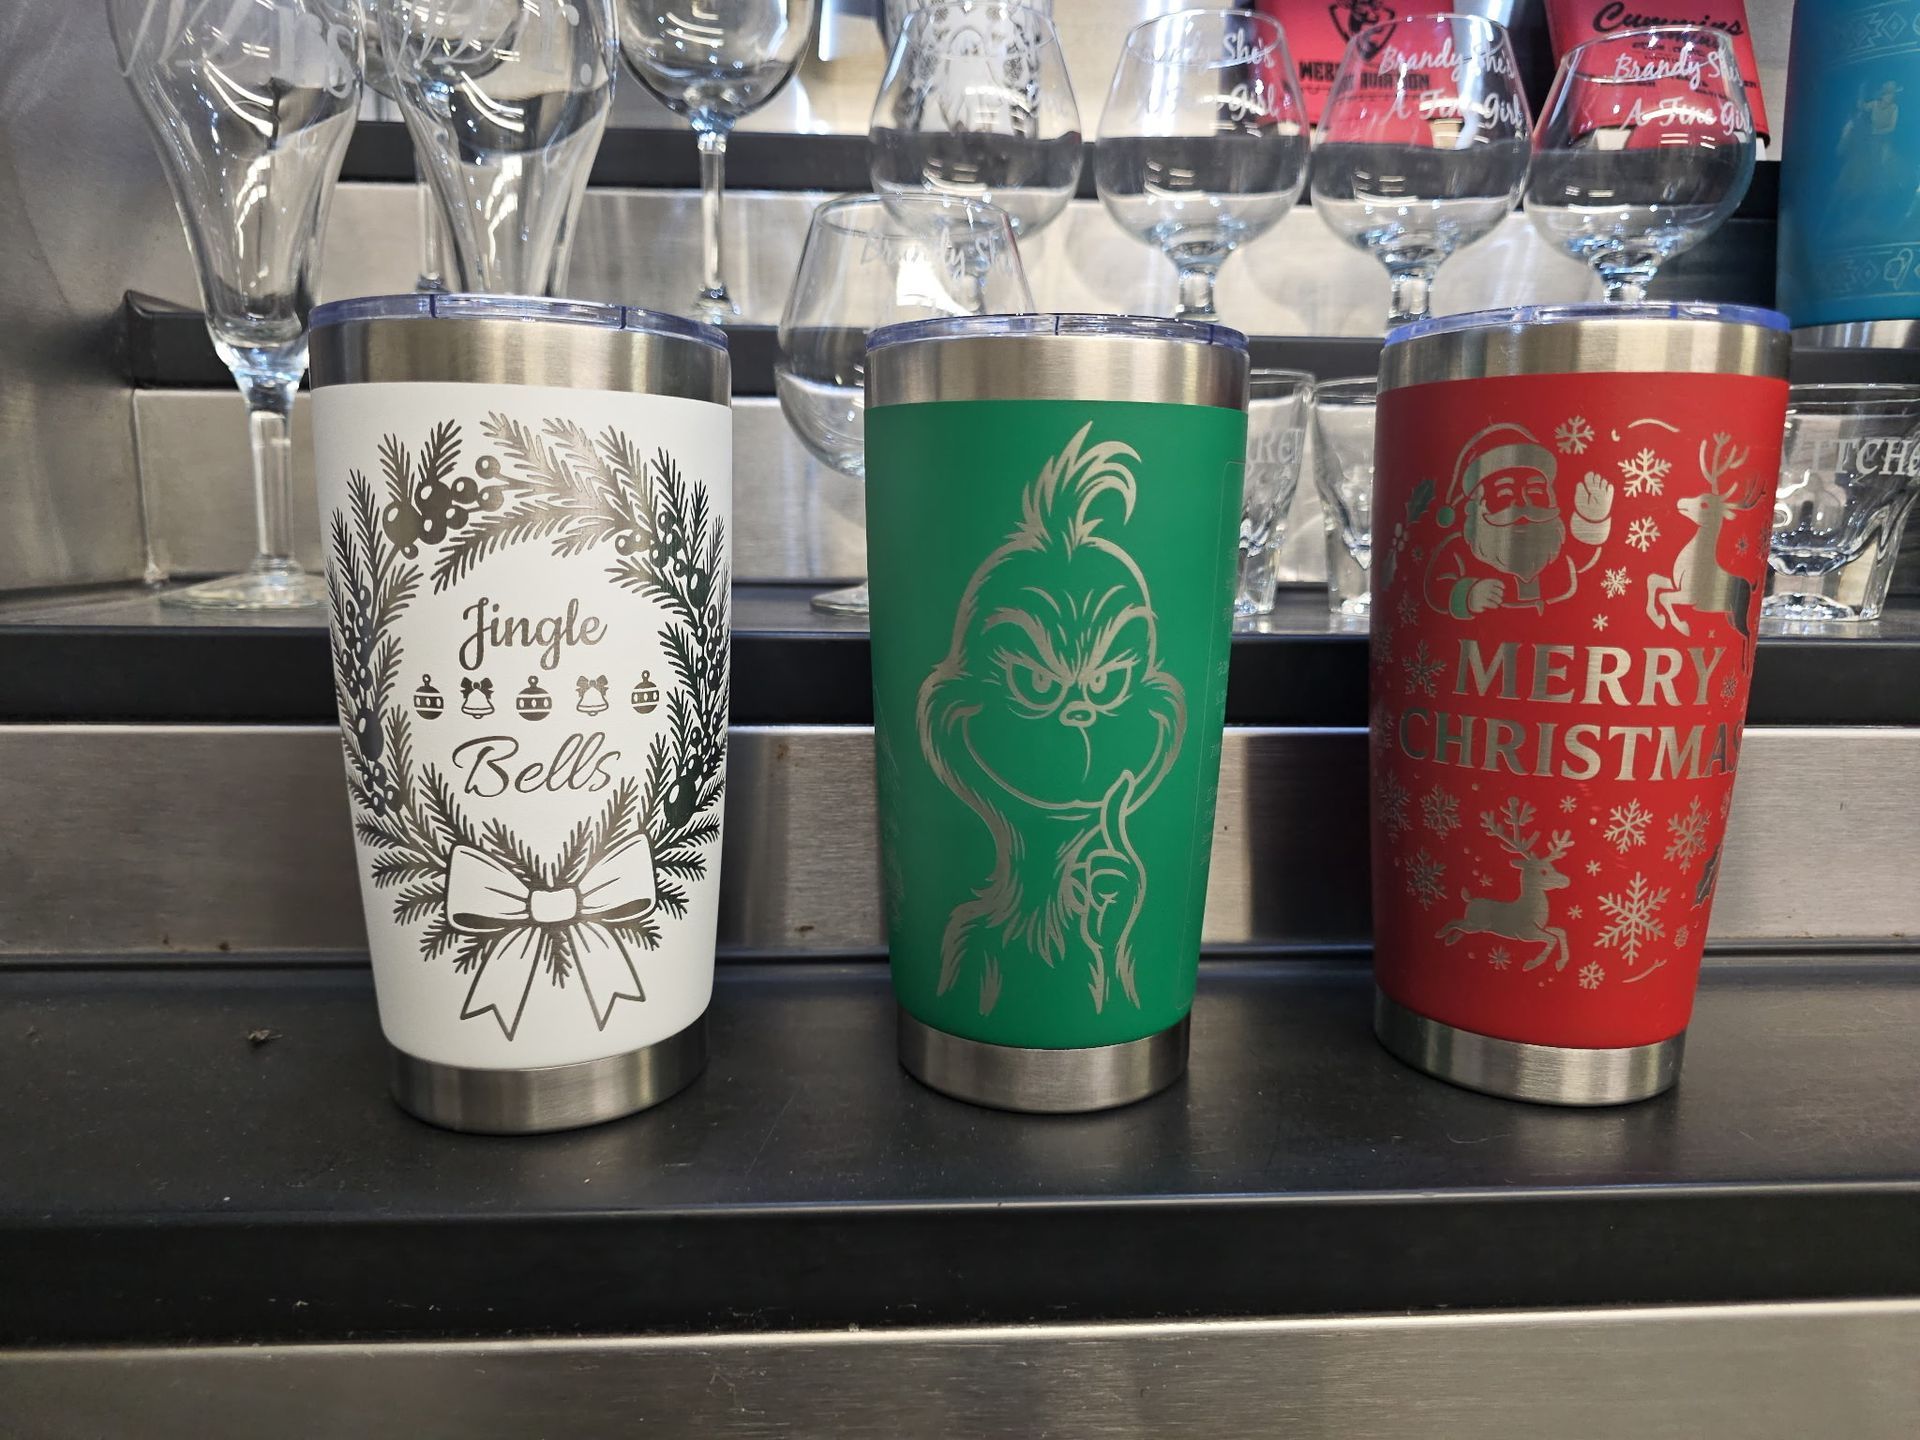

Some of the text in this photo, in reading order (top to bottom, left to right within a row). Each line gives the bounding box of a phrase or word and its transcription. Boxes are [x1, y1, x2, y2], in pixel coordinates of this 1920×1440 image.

[1593, 1, 1744, 36] Cummins
[1378, 37, 1464, 82] Brandy
[1613, 45, 1702, 91] Brandy
[1483, 92, 1524, 129] Girl
[1619, 97, 1651, 131] A
[1658, 96, 1717, 127] Fine
[458, 596, 608, 671] Jingle
[1452, 638, 1727, 706] MERRY
[452, 731, 621, 798] Bells
